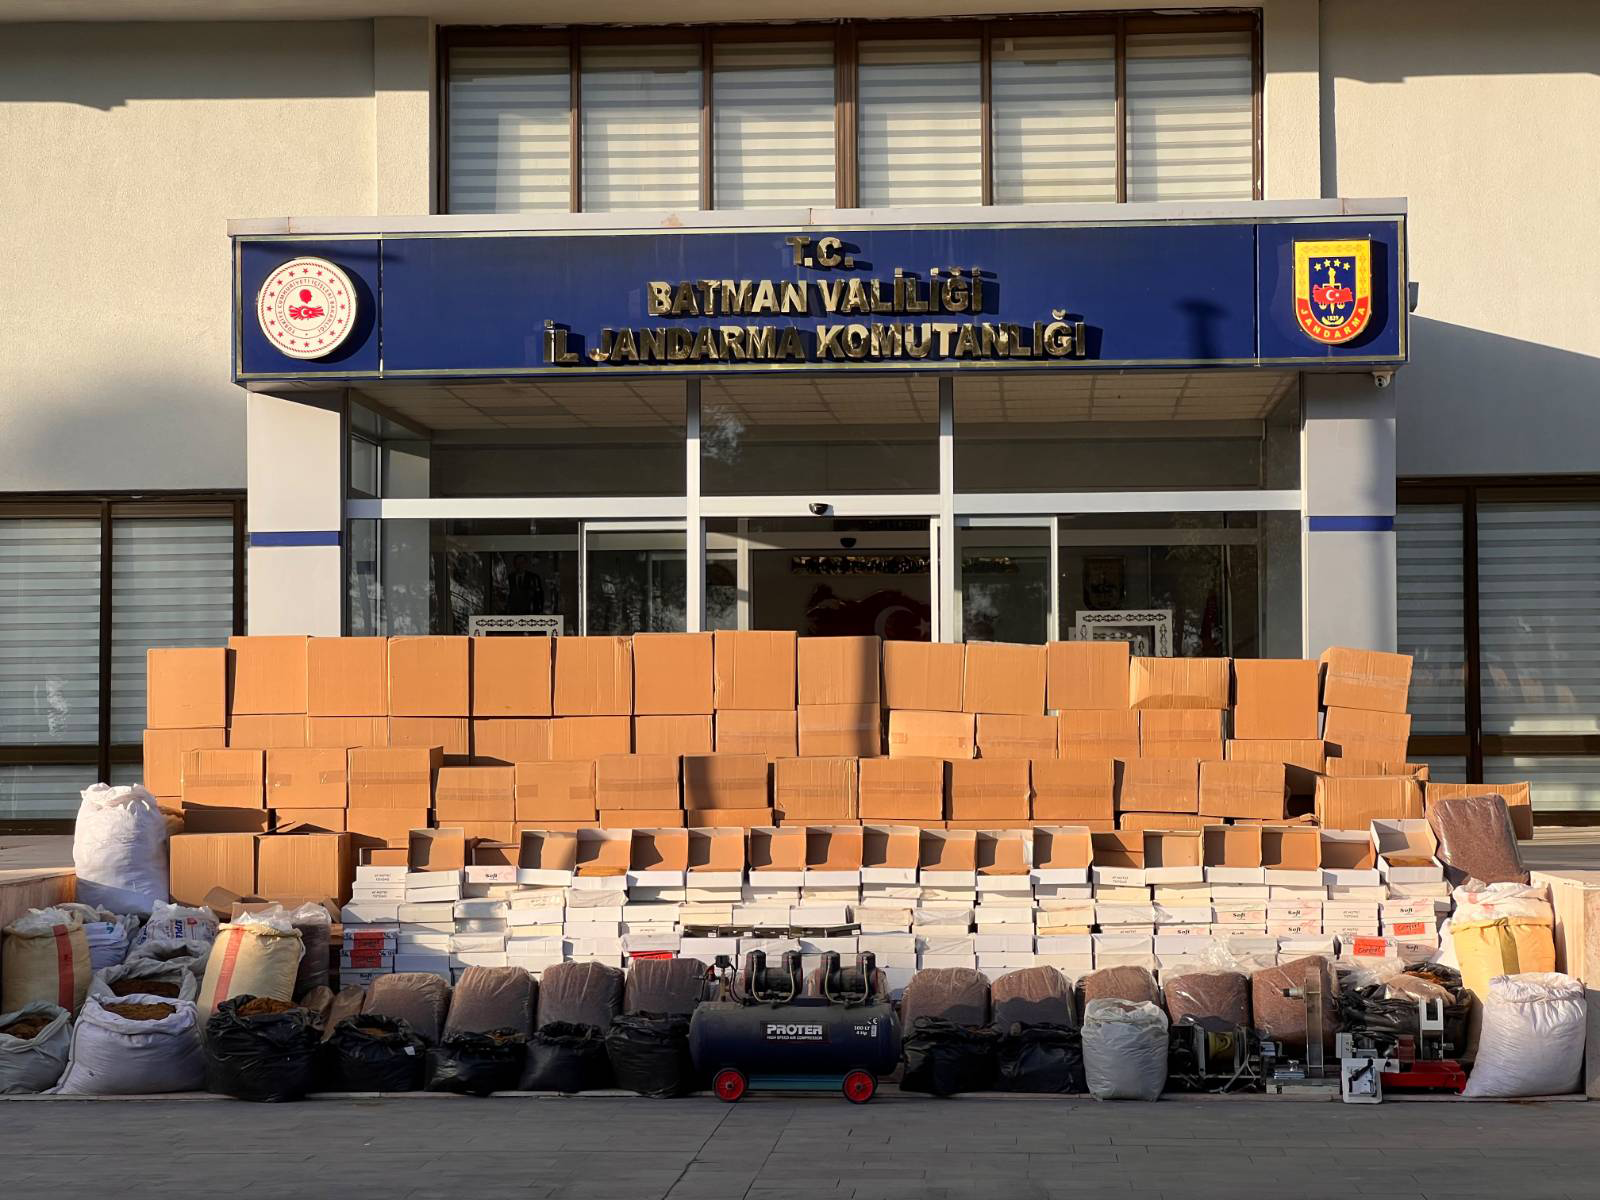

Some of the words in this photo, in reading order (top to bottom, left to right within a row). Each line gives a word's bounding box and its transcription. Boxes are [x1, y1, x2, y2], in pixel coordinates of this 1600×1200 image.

[785, 236, 855, 268] T.C.
[648, 279, 808, 317] BATMAN
[816, 267, 983, 315] VALİLİĞİ
[543, 319, 580, 364] İL
[588, 325, 808, 362] JANDARMA
[816, 308, 1087, 360] KOMUTANLIĞI
[766, 1024, 823, 1035] PROTER
